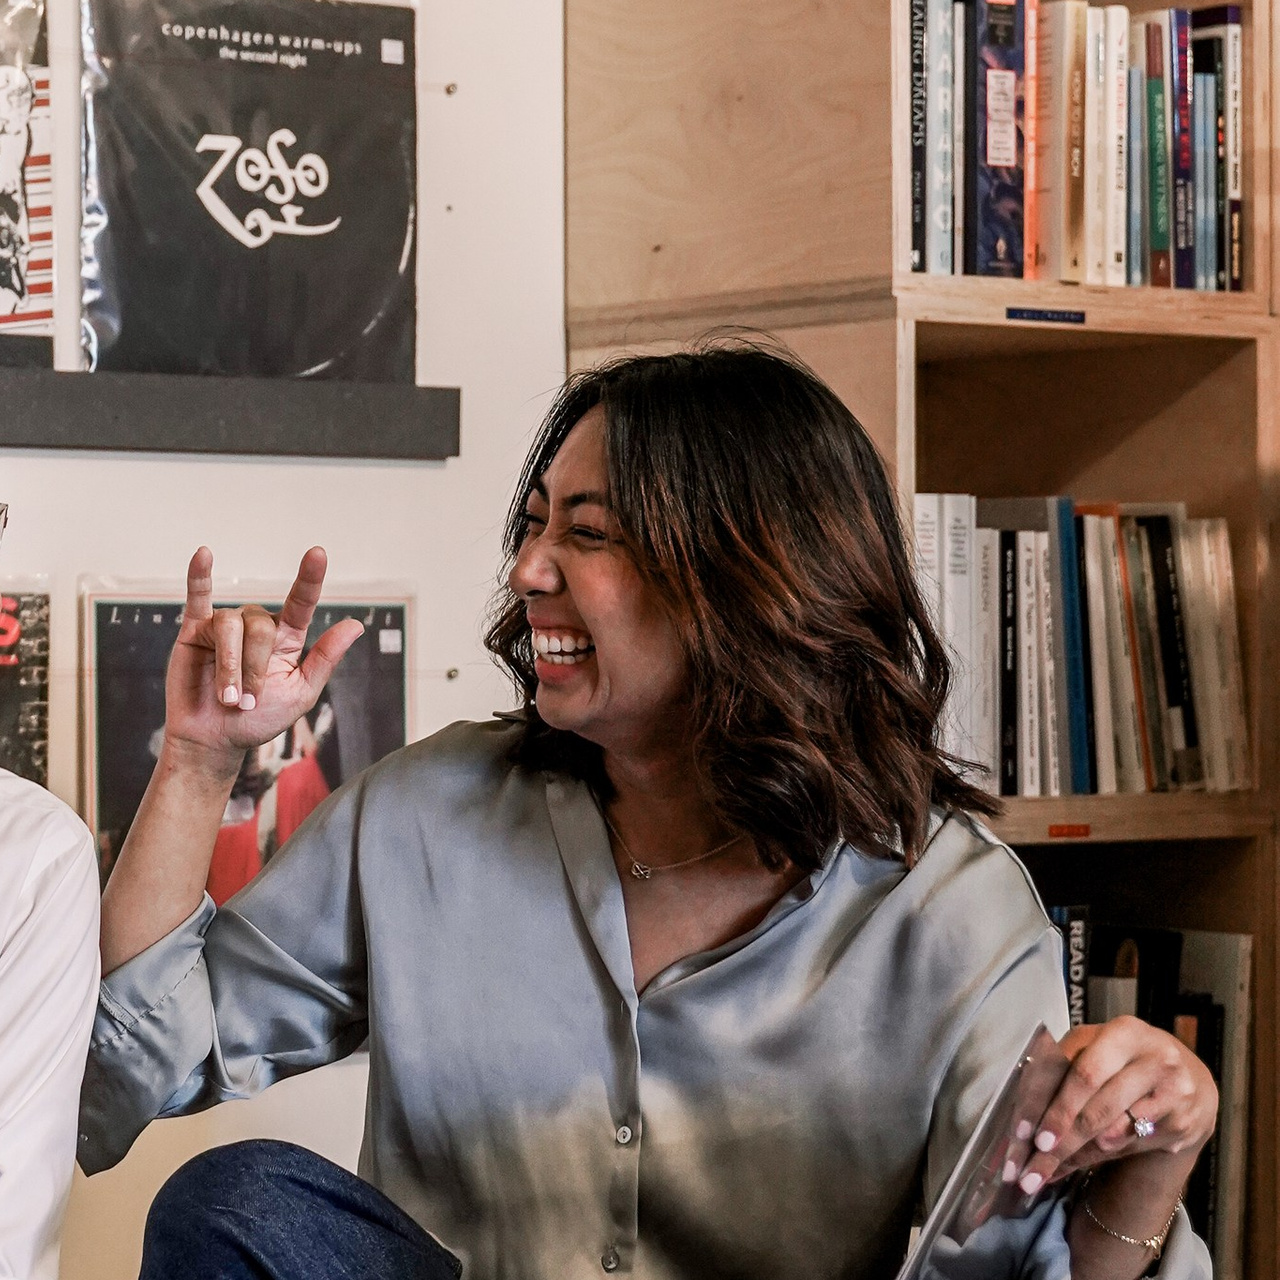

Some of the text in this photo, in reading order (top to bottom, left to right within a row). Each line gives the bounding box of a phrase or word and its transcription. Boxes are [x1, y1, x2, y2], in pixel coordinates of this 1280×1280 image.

[161, 23, 363, 57] copenhagen warm-ups
[239, 49, 278, 65] second
[278, 53, 308, 69] night
[1070, 919, 1085, 982] READ
